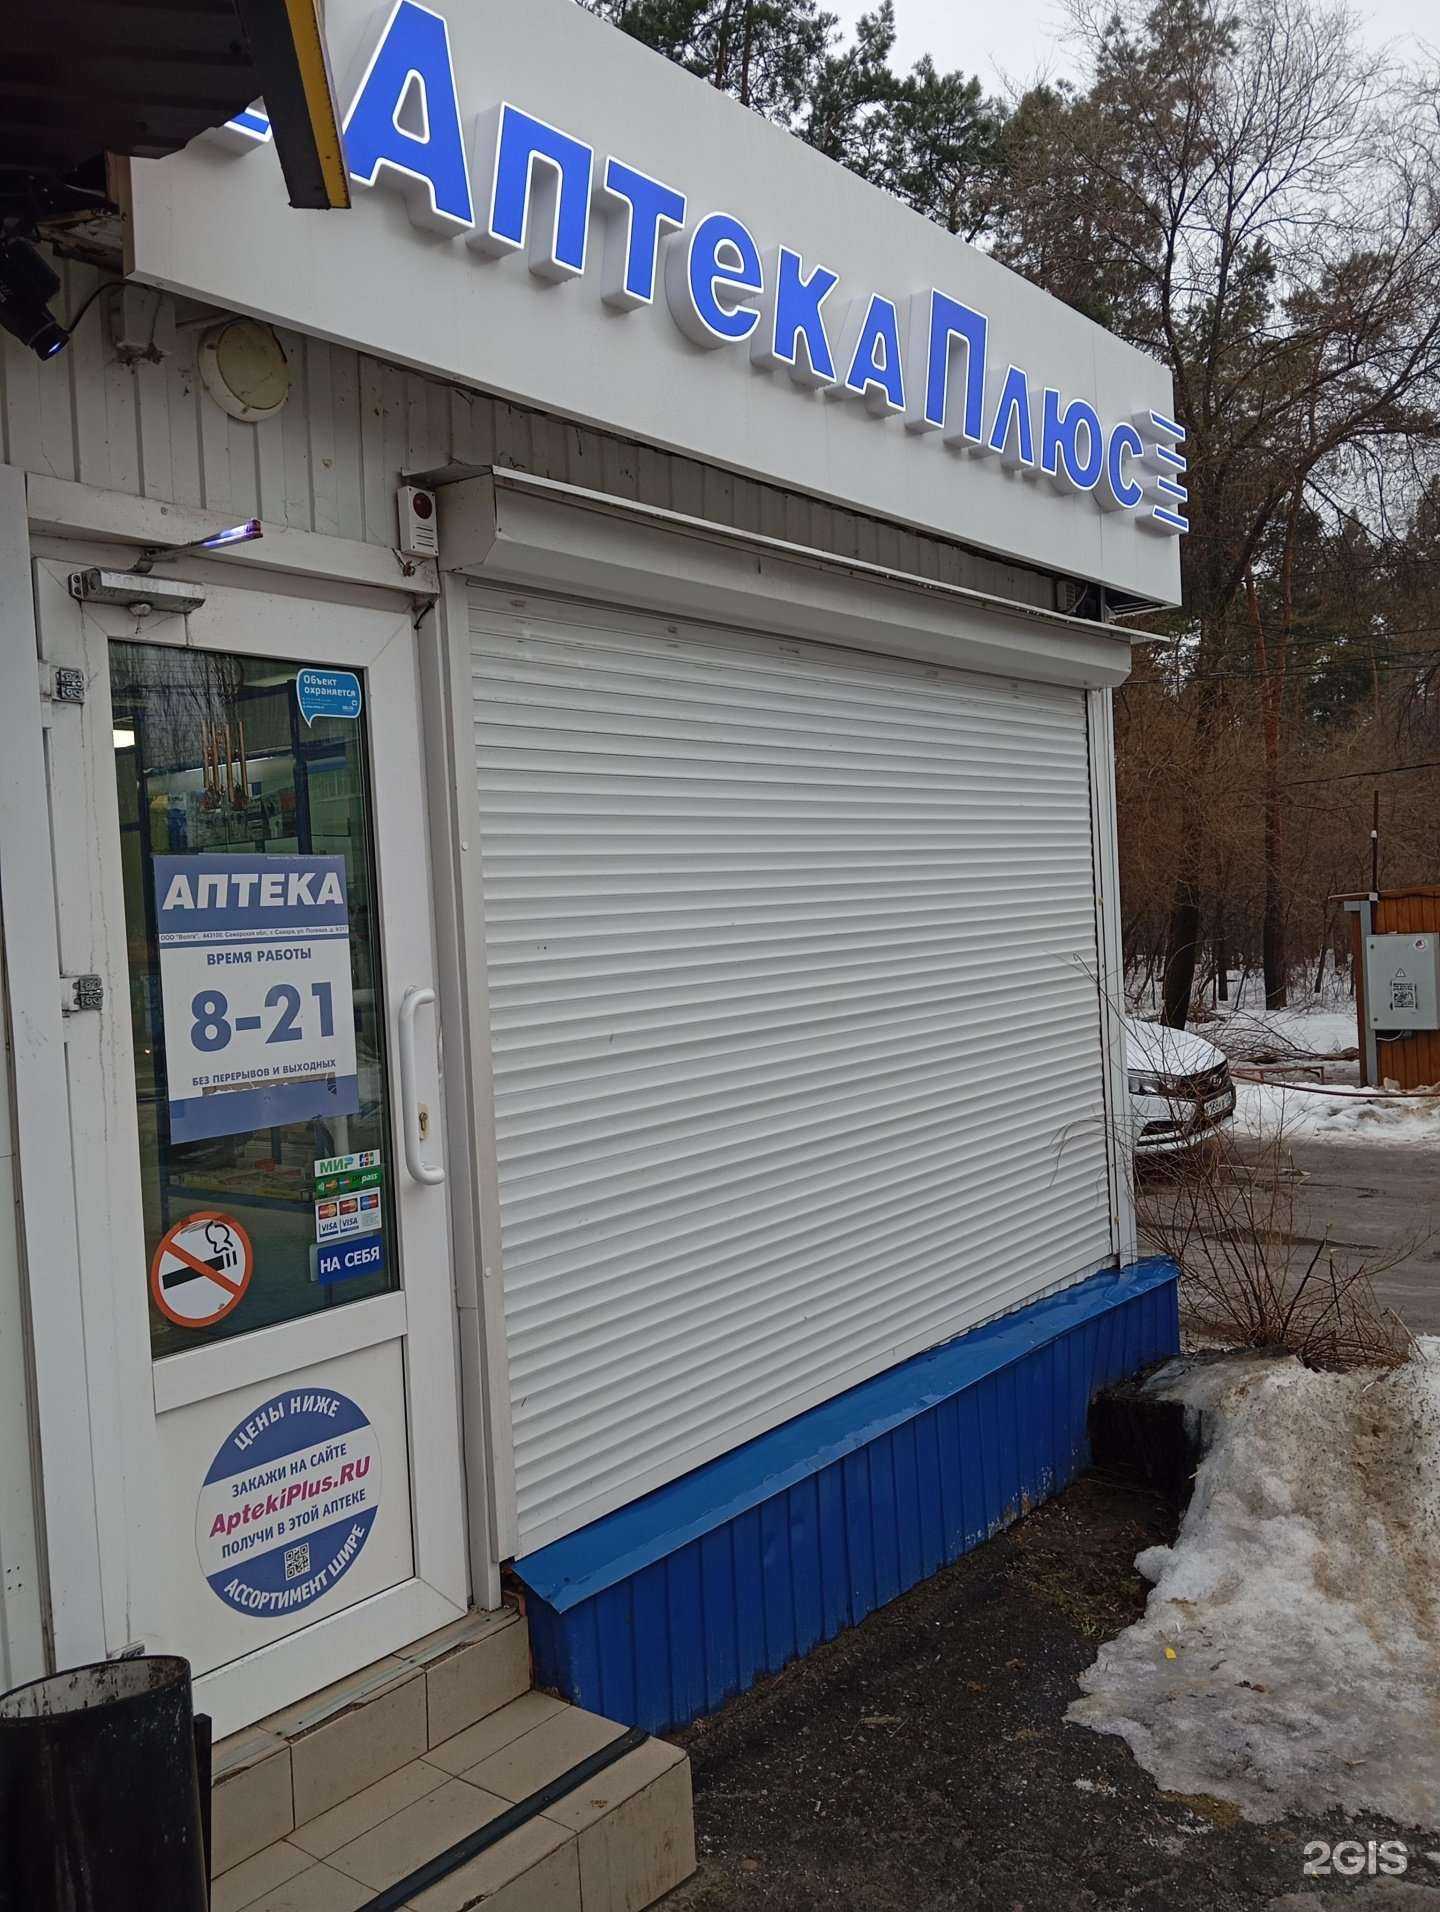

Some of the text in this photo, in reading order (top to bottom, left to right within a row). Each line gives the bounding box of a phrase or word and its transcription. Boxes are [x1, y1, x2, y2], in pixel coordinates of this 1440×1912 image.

[303, 675, 337, 686] Объект
[304, 687, 356, 697] охраняется
[162, 872, 344, 910] АПТЕКА
[207, 948, 312, 965] ВРЕМЯ РАБОТЫ
[190, 982, 334, 1052] 8-21
[192, 1059, 336, 1087] БЕЗ ПЕРЕРЫВОВ И ВЫХОДНЫХ
[320, 1156, 354, 1173] МИР
[322, 1222, 338, 1232] VISA
[342, 1217, 358, 1227] VISA
[320, 1246, 380, 1274] НА СЕБЯ
[233, 1395, 341, 1451] ЦЕНЫ НИЖЕ
[231, 1443, 348, 1498] ЗАКАЖИ НА САЙТЕ
[209, 1455, 371, 1538] AptekiPlus.RU
[221, 1488, 367, 1559] ПОЛУЧИ В ЭТОЙ АПТЕКЕ
[224, 1523, 366, 1610] АССОРТИМЕНТ ШИРЕ
